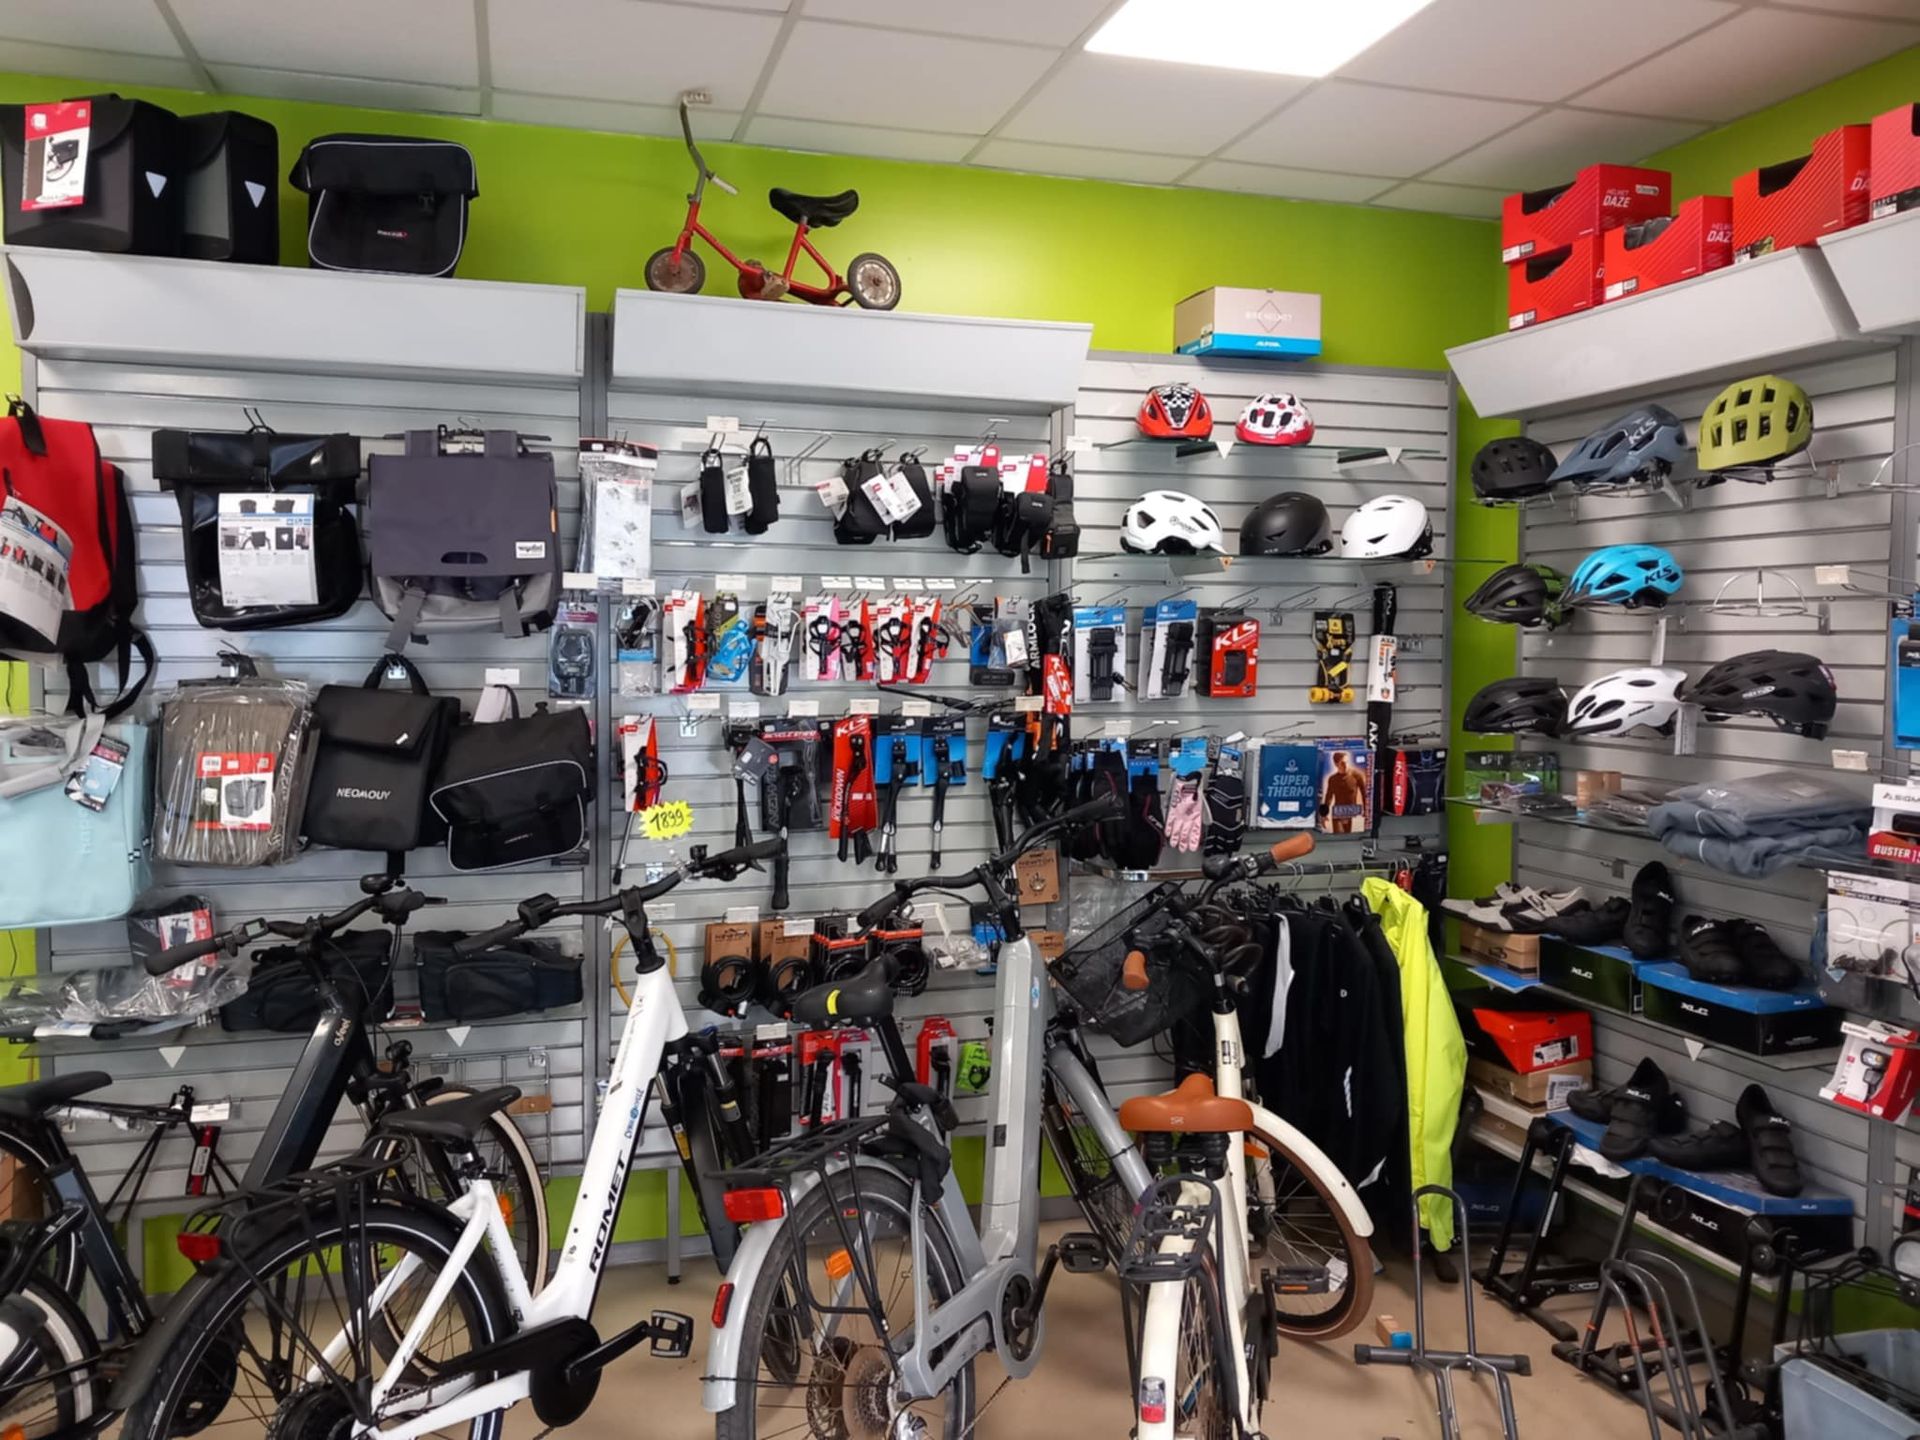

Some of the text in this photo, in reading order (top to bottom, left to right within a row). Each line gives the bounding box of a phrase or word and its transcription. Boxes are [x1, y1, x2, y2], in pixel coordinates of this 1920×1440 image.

[1603, 195, 1631, 208] DAZE
[1707, 231, 1733, 244] DAZ
[1629, 417, 1657, 444] KLS
[1645, 565, 1672, 585] KLS
[1027, 603, 1041, 668] ARMLOCK
[1215, 621, 1257, 651] KLS
[836, 717, 868, 738] KLS
[1273, 774, 1310, 786] SUPER
[1267, 786, 1314, 797] THERMO
[649, 808, 685, 832] 1899
[1873, 843, 1911, 858] BUSTER
[1571, 966, 1593, 980] XLC
[1680, 1002, 1709, 1016] XLC
[1625, 1087, 1650, 1100] XLC
[1769, 1115, 1790, 1126] XLC
[588, 1150, 626, 1274] ROMET
[1690, 1212, 1719, 1231] XLC
